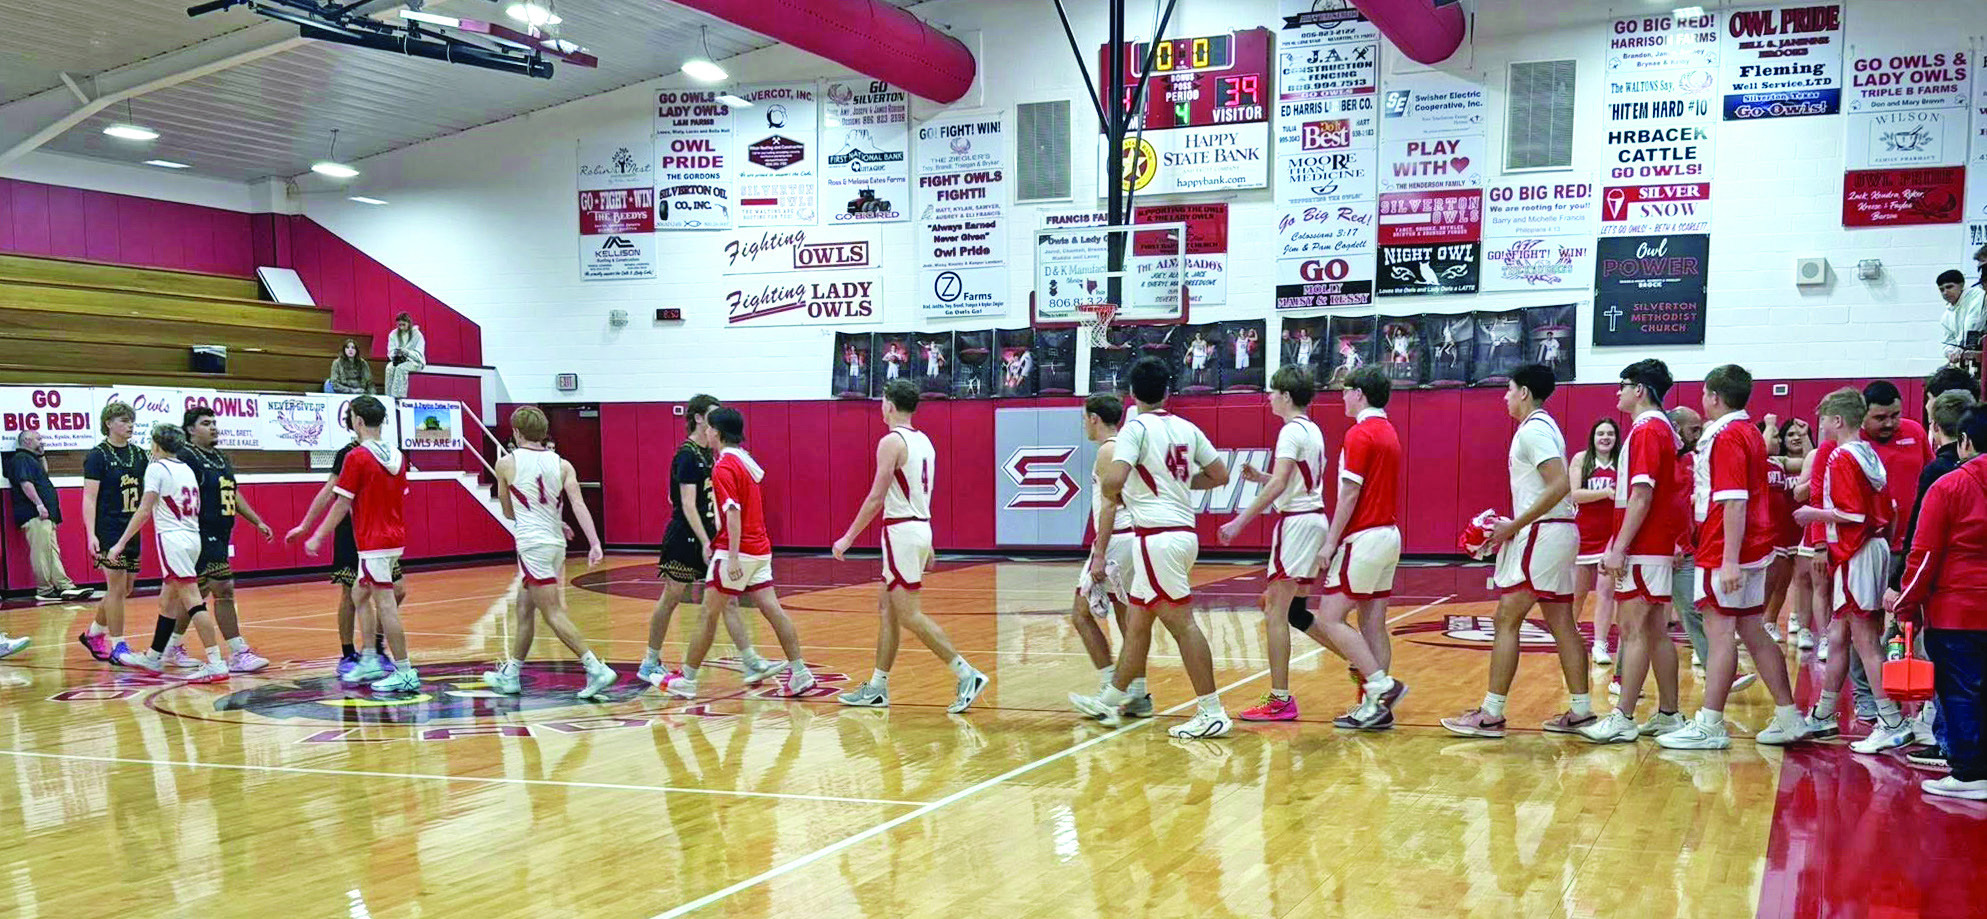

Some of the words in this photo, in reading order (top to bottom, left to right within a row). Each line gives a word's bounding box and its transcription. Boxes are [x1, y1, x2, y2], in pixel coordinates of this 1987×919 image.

[1614, 20, 1638, 34] GO
[1644, 18, 1671, 32] BIG
[1677, 14, 1714, 28] RED!
[1729, 10, 1778, 38] OWL
[1780, 5, 1840, 34] PRIDE
[1307, 48, 1348, 64] J.A.
[1854, 58, 1882, 72] GO
[1890, 54, 1945, 69] OWLS
[1952, 52, 1967, 66] &
[1170, 72, 1194, 82] BONUS
[1309, 71, 1356, 81] FENCING
[1740, 62, 1826, 78] Fleming
[1853, 72, 1906, 87] LADY
[1910, 68, 1966, 84] OWLS
[870, 81, 888, 93] GO
[1225, 76, 1258, 106] 39
[1612, 83, 1624, 94] The
[1626, 82, 1658, 92] WALTONS
[1861, 88, 1900, 98] TRIPLE
[1906, 86, 1913, 95] B
[1917, 84, 1958, 94] FARMS
[660, 93, 676, 104] GO
[680, 92, 715, 103] OWLS
[796, 90, 814, 102] INC.
[853, 92, 904, 104] SILVERTON
[1166, 90, 1199, 102] PERIOD
[1386, 92, 1408, 113] SE
[1416, 94, 1448, 102] Swisher
[1450, 90, 1480, 99] Electric
[1871, 100, 1884, 108] Don
[1902, 99, 1920, 107] Mary
[659, 106, 690, 118] LADY
[694, 105, 728, 116] OWLS
[1176, 103, 1188, 124] 4
[1281, 106, 1291, 116] ED
[1294, 102, 1322, 115] HARRIS
[1360, 98, 1372, 110] CO.
[1415, 102, 1466, 111] Cooperative,
[1468, 100, 1482, 108] Inc.
[1653, 100, 1684, 118] HARD
[1735, 105, 1764, 118] Go
[1768, 101, 1827, 116] Owls!
[1213, 106, 1262, 122] VISITOR
[1875, 112, 1940, 125] WILSON
[920, 128, 938, 140] GO!
[940, 124, 974, 138] FIGHT!
[977, 122, 1000, 134] WIN!
[1304, 126, 1348, 149] Best
[1609, 128, 1708, 144] HRBACEK
[671, 140, 716, 152] OWL
[1185, 133, 1238, 149] HAPPY
[1407, 140, 1460, 156] PLAY
[662, 156, 724, 168] PRIDE
[830, 155, 848, 164] FIRST
[884, 152, 903, 160] BANK
[1164, 152, 1210, 167] STATE
[1215, 148, 1260, 162] BANK
[1618, 146, 1696, 162] CATTLE
[628, 162, 651, 174] Nest
[1288, 166, 1325, 175] THAN
[1290, 169, 1364, 183] MEDICINE
[1393, 160, 1447, 177] WITH
[1612, 167, 1634, 178] GO
[1640, 164, 1702, 176] OWLS!
[920, 174, 960, 188] FIGHT
[964, 171, 1002, 184] OWLS
[1177, 176, 1246, 189] happybank.com
[1409, 180, 1444, 188] HENDERSON
[581, 193, 593, 210] GO
[600, 191, 628, 210] FIGHT
[634, 190, 652, 208] WIN
[660, 185, 712, 200] SILVERTON
[714, 187, 728, 200] OIL
[1490, 188, 1512, 201] GO
[1520, 186, 1547, 200] BIG
[1554, 184, 1592, 198] RED!
[1639, 186, 1700, 199] SILVER
[694, 201, 712, 210] INC.
[1380, 196, 1480, 213] SILVERTON
[1521, 202, 1552, 212] rooting
[1640, 204, 1697, 218] SNOW
[614, 211, 648, 223] BEEDYS
[965, 220, 996, 229] Earned
[1046, 214, 1089, 224] FRANCIS
[1278, 214, 1296, 234] Go
[1304, 208, 1329, 224] Big
[1337, 207, 1372, 226] Red!
[1432, 210, 1479, 224] OWLS
[1291, 231, 1332, 241] Colossians
[1336, 228, 1358, 238] 3:17
[595, 249, 640, 258] KELLISON
[724, 230, 806, 266] Fighting
[934, 247, 956, 258] Owl
[960, 246, 990, 256] Pride
[1283, 245, 1298, 254] Jim
[1302, 243, 1308, 251] &
[1312, 242, 1331, 250] Pam
[1335, 240, 1366, 250] Cogdell
[1384, 247, 1434, 264] NIGHT
[1438, 245, 1474, 261] OWL
[1636, 238, 1668, 259] Owl
[798, 246, 864, 265] OWLS
[1300, 258, 1349, 281] GO
[1603, 257, 1699, 277] POWER
[812, 282, 872, 299] LADY
[942, 276, 954, 296] Z
[726, 284, 806, 314] Fighting
[964, 292, 992, 300] Farms
[1316, 296, 1328, 306] &
[808, 300, 872, 318] OWLS
[1634, 302, 1697, 311] SILVERTON
[1632, 313, 1697, 322] METHODIST
[1642, 324, 1686, 332] CHURCH
[560, 376, 572, 388] EXIT
[32, 390, 61, 408] GO
[133, 394, 170, 414] Owls
[212, 397, 258, 418] OWLS!
[4, 413, 40, 432] BIG
[47, 412, 90, 430] RED!
[405, 438, 430, 448] OWLS
[433, 438, 450, 448] ARE
[452, 438, 461, 448] #1
[1165, 444, 1189, 482] 45
[1000, 446, 1082, 510] S
[536, 474, 547, 504] 1
[122, 488, 138, 512] 12
[222, 489, 236, 516] 55
